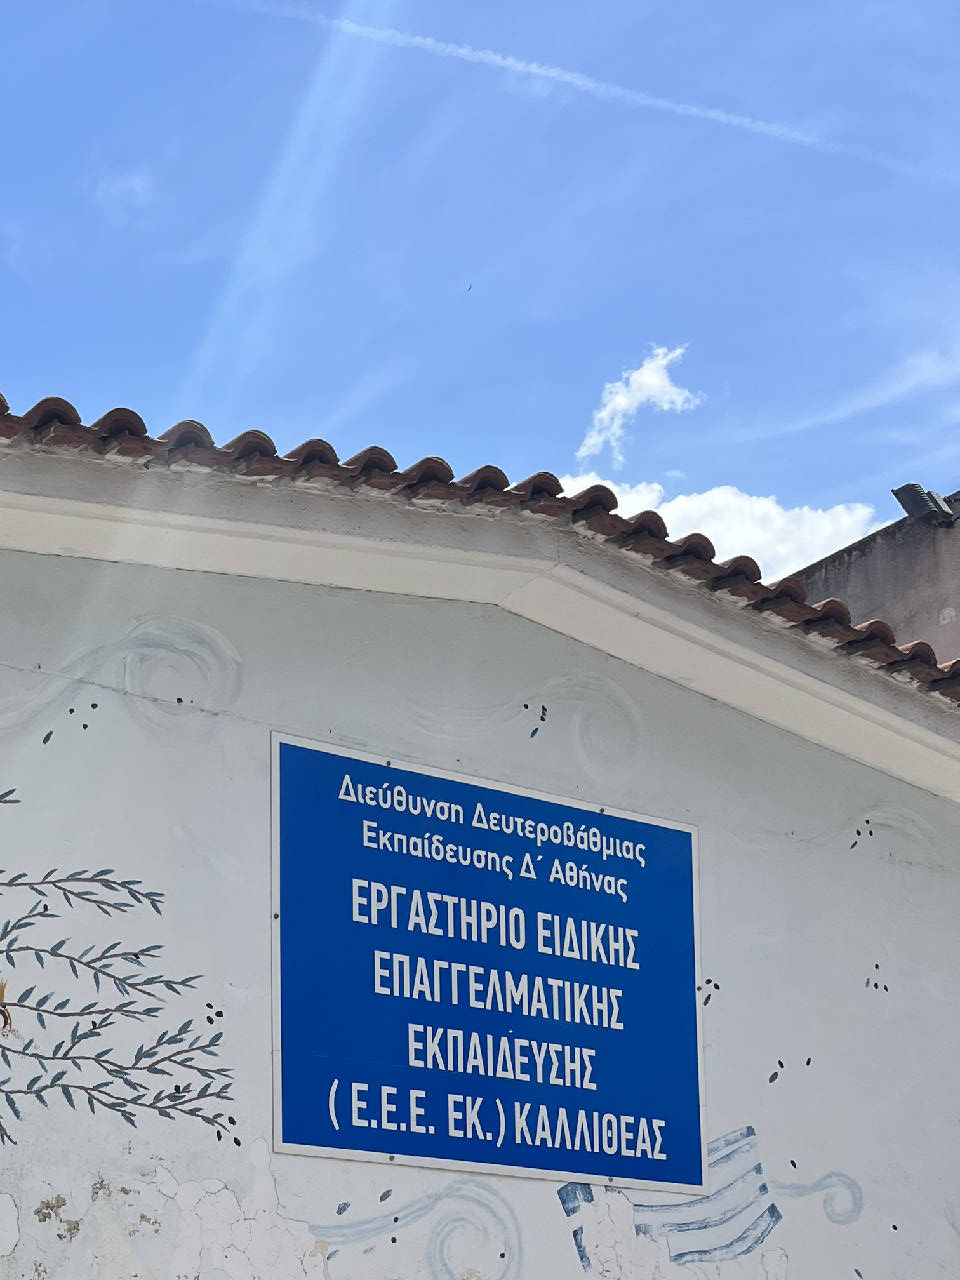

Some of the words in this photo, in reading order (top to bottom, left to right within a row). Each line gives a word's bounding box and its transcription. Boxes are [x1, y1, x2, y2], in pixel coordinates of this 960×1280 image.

[338, 774, 464, 824] Διεύθυνση
[471, 802, 646, 868] Δευτεροβάθμιας
[362, 819, 514, 881] Εκπαίδευσης
[549, 858, 628, 903] Αθήνας
[351, 878, 526, 950] ΕΡΓΑΣΤΗΡΙΟ
[537, 911, 640, 970] ΕΙΔΙΚΗΣ
[374, 949, 624, 1030] ΕΠΑΓΓΕΛΜΑΤΙΚΗΣ
[407, 1023, 597, 1091] ΕΚΠΑΙΔΕΥΣΗΣ
[514, 1101, 667, 1160] ΚΑΛΛΙΘΕΑΣ
